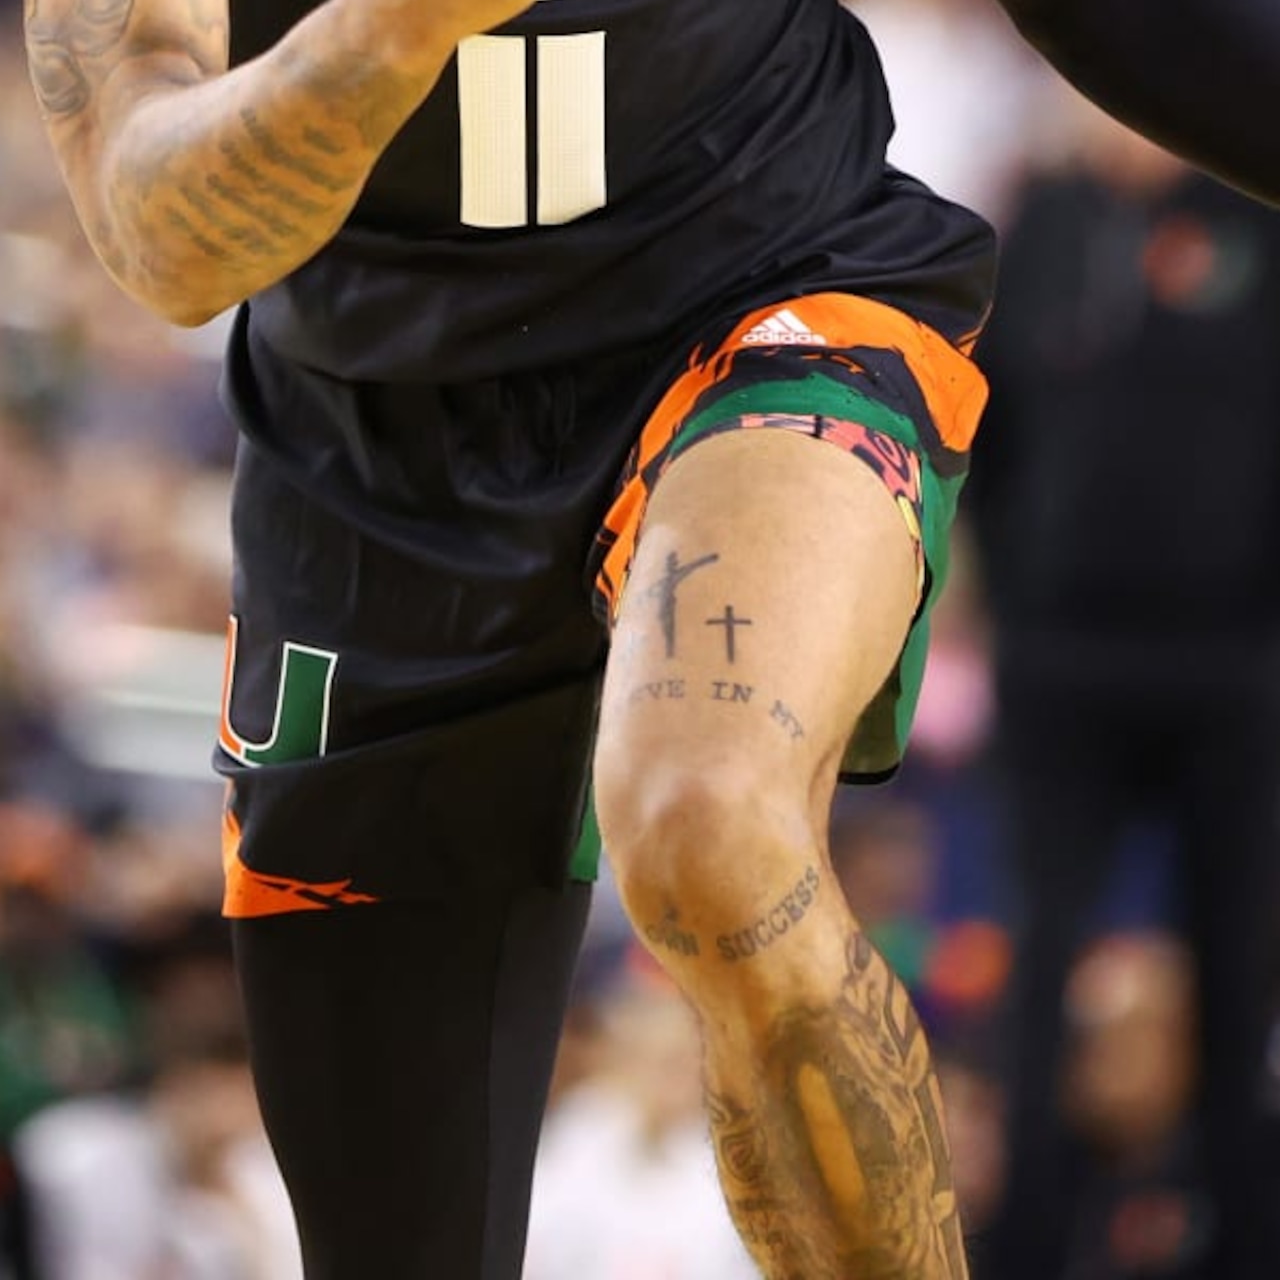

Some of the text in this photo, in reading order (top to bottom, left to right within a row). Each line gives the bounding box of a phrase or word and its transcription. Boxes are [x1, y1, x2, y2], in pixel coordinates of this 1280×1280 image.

[457, 31, 607, 228] 11
[219, 614, 339, 768] U
[711, 680, 754, 704] IN
[716, 864, 821, 962] SUCCESS
